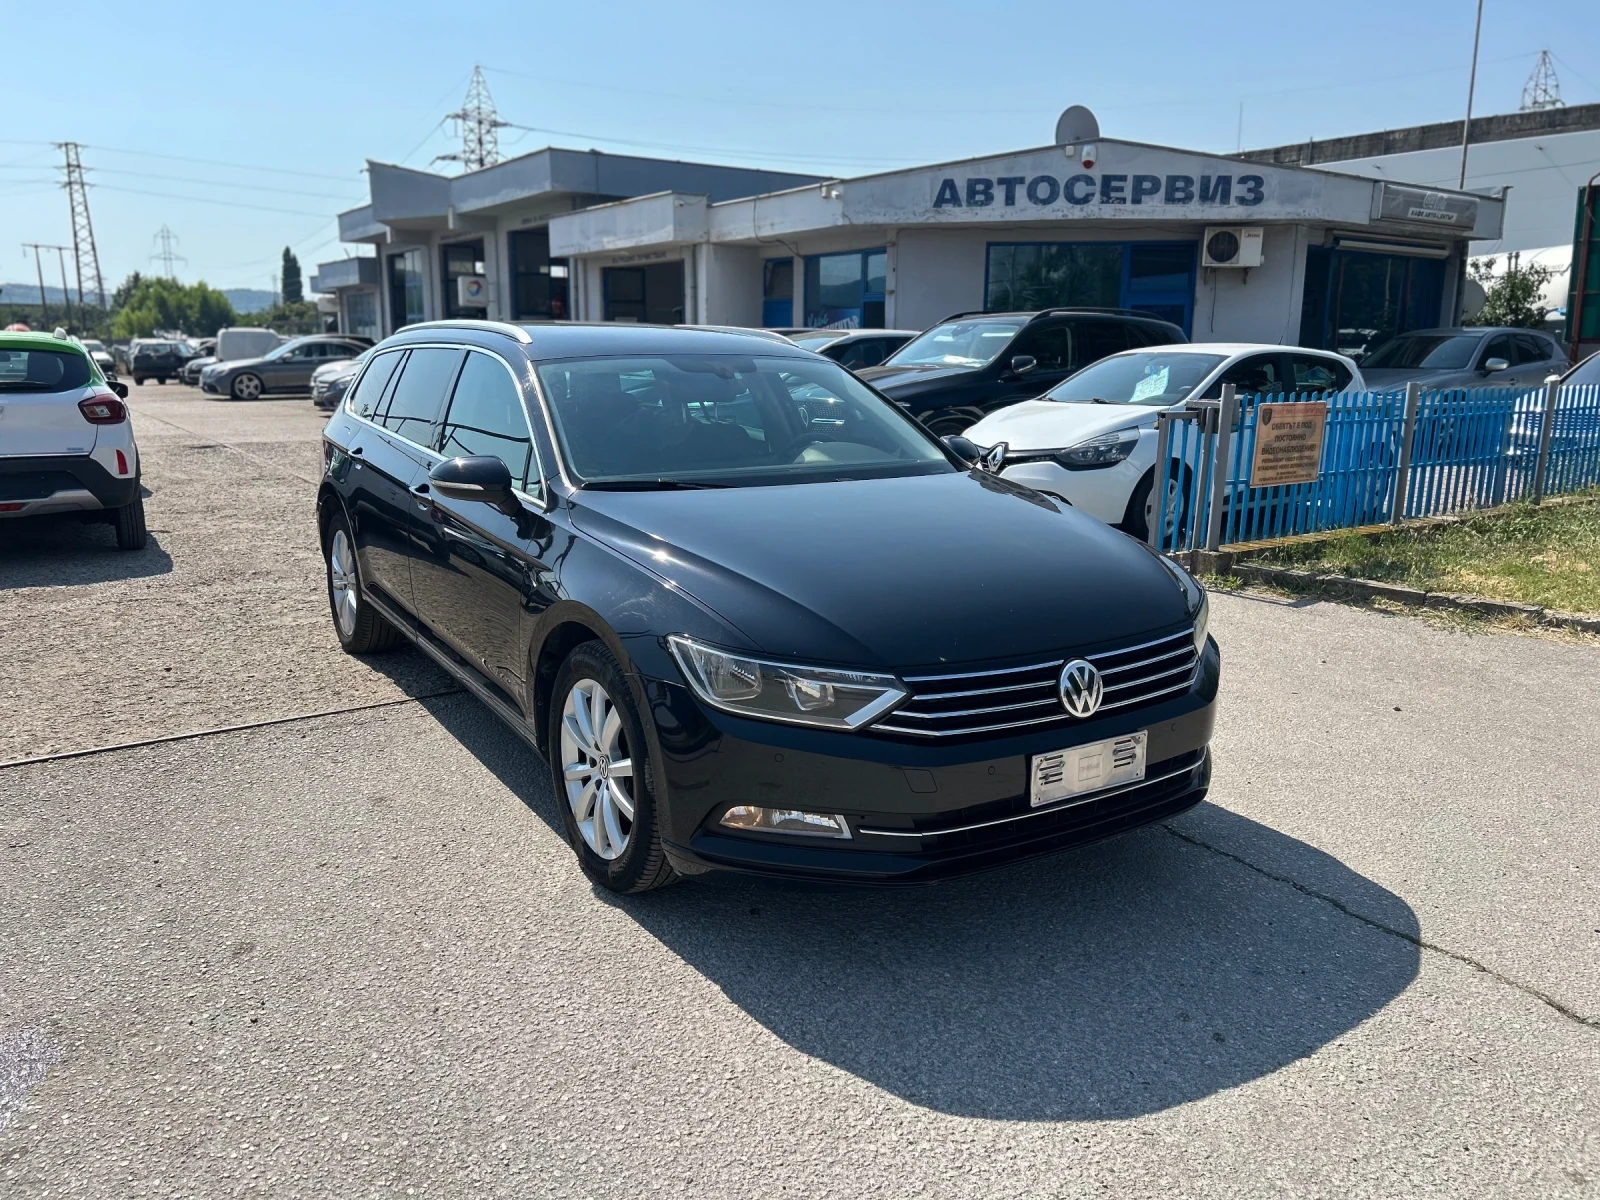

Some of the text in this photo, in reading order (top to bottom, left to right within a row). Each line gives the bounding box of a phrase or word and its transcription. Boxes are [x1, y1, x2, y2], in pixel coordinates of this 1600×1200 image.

[932, 173, 1266, 209] АВТОСЕРВИЗ
[1301, 421, 1313, 429] ПОД
[1274, 434, 1307, 443] ПОСТОЯННО
